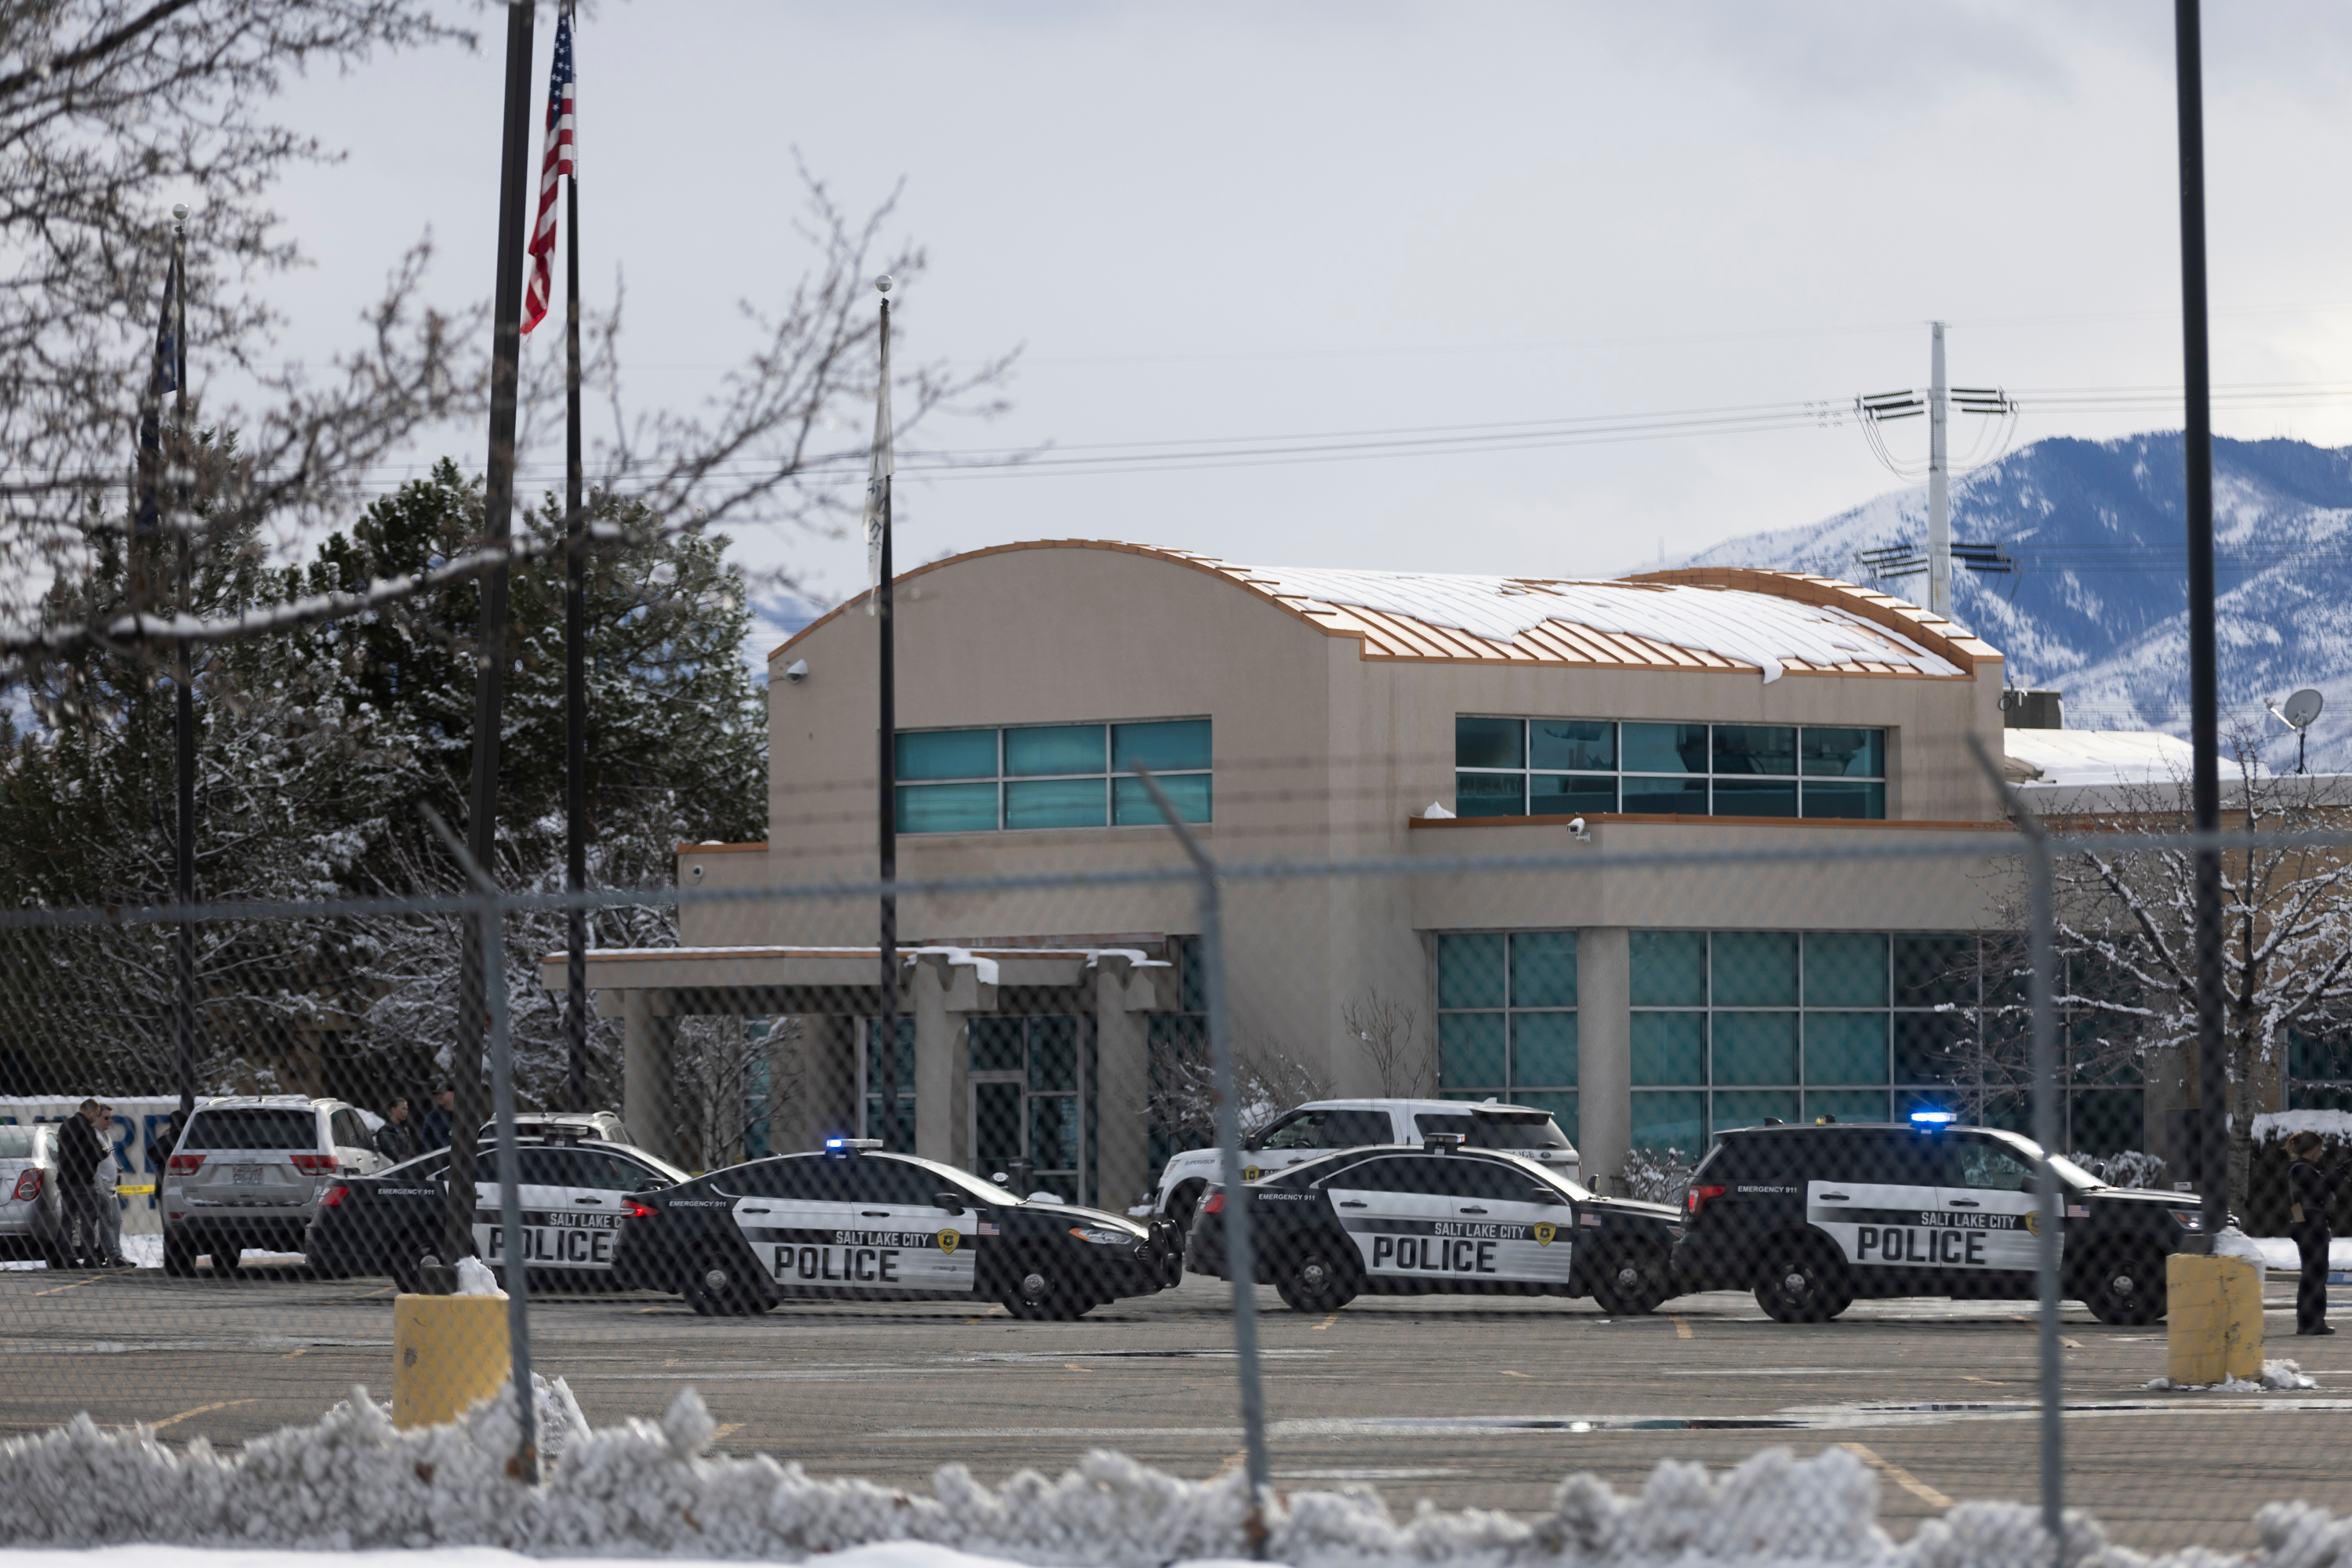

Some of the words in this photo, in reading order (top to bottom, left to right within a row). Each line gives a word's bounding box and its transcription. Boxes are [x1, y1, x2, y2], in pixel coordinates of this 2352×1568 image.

[550, 1213, 579, 1227] SALT
[580, 1214, 611, 1229] LAKE
[1921, 1212, 1951, 1226] SALT
[1954, 1214, 1986, 1228] LAKE
[1989, 1214, 2016, 1229] CITY
[836, 1231, 865, 1245] SALT
[868, 1232, 899, 1246] LAKE
[902, 1232, 930, 1247] CITY
[1435, 1222, 1463, 1236] SALT
[1465, 1224, 1497, 1238] LAKE
[1500, 1225, 1526, 1239] CITY
[1857, 1226, 1987, 1265] POLICE
[1373, 1236, 1498, 1273] POLICE
[775, 1246, 901, 1283] POLICE
